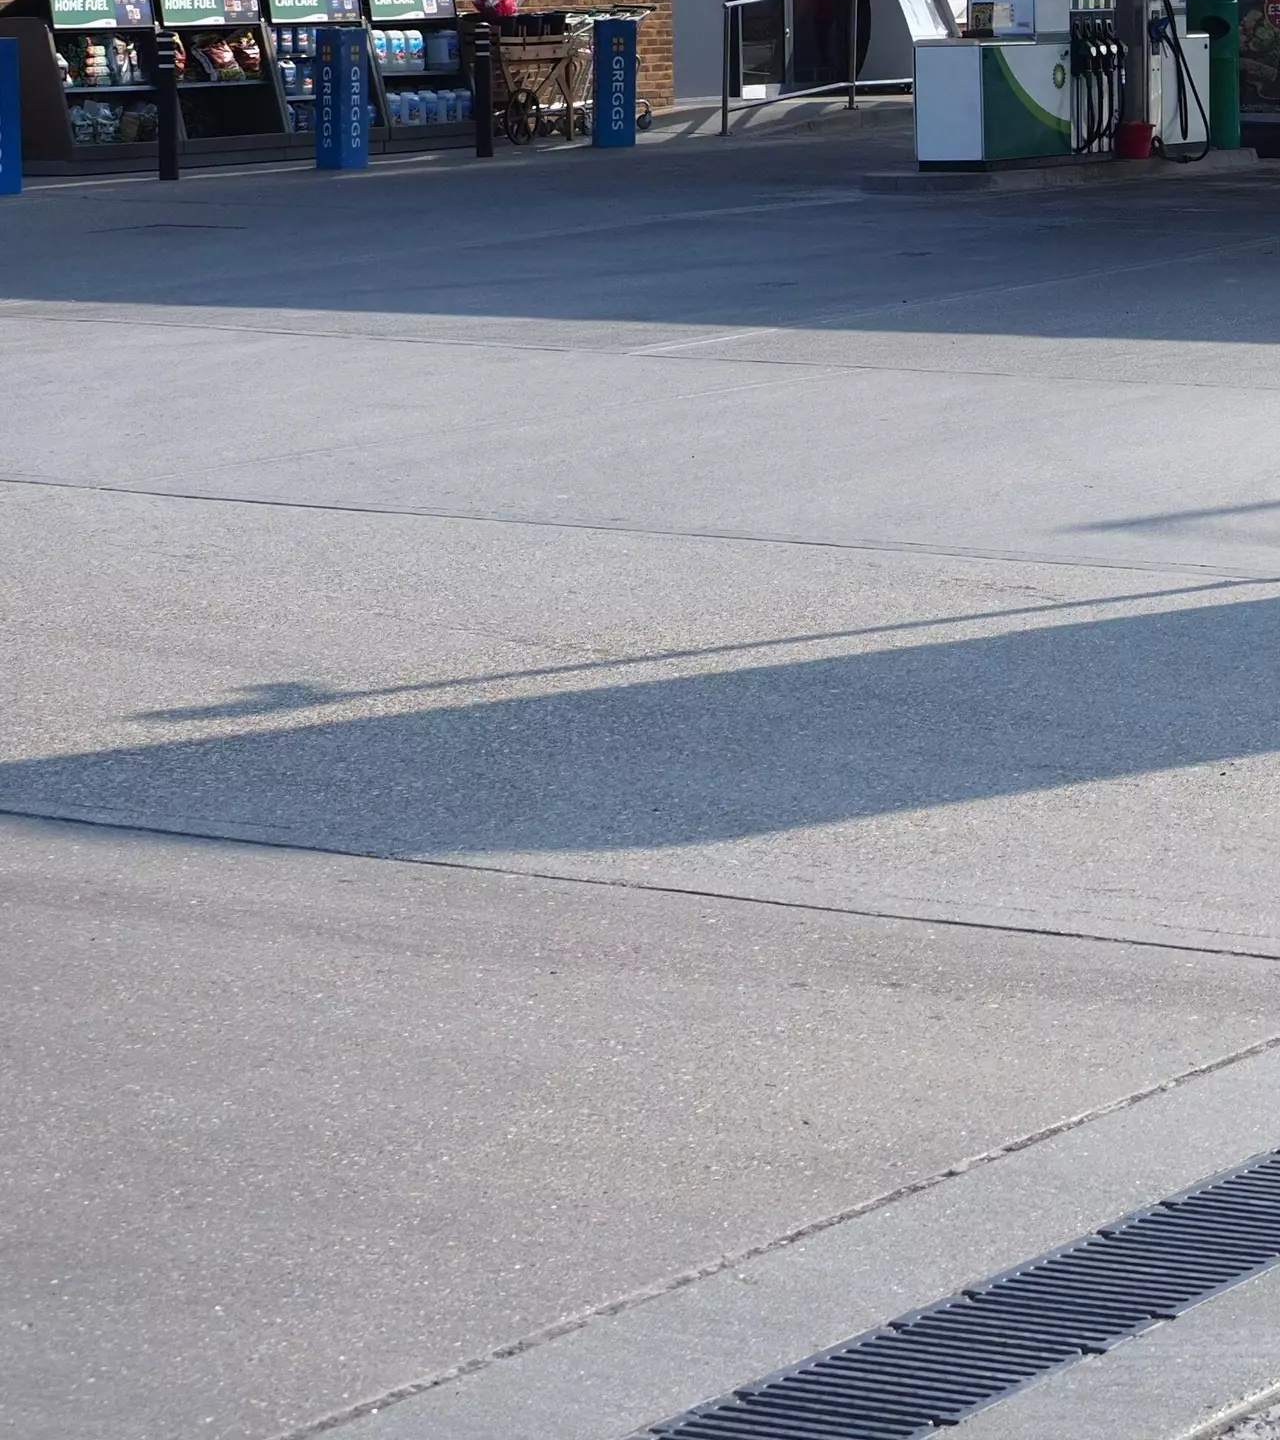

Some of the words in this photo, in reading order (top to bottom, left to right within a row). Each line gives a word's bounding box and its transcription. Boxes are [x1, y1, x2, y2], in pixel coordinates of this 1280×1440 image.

[54, 0, 83, 12] HOME
[85, 0, 109, 11] FUEL
[322, 66, 332, 148] GREGGS
[351, 66, 360, 148] GREGGS
[612, 56, 624, 130] GREGGS
